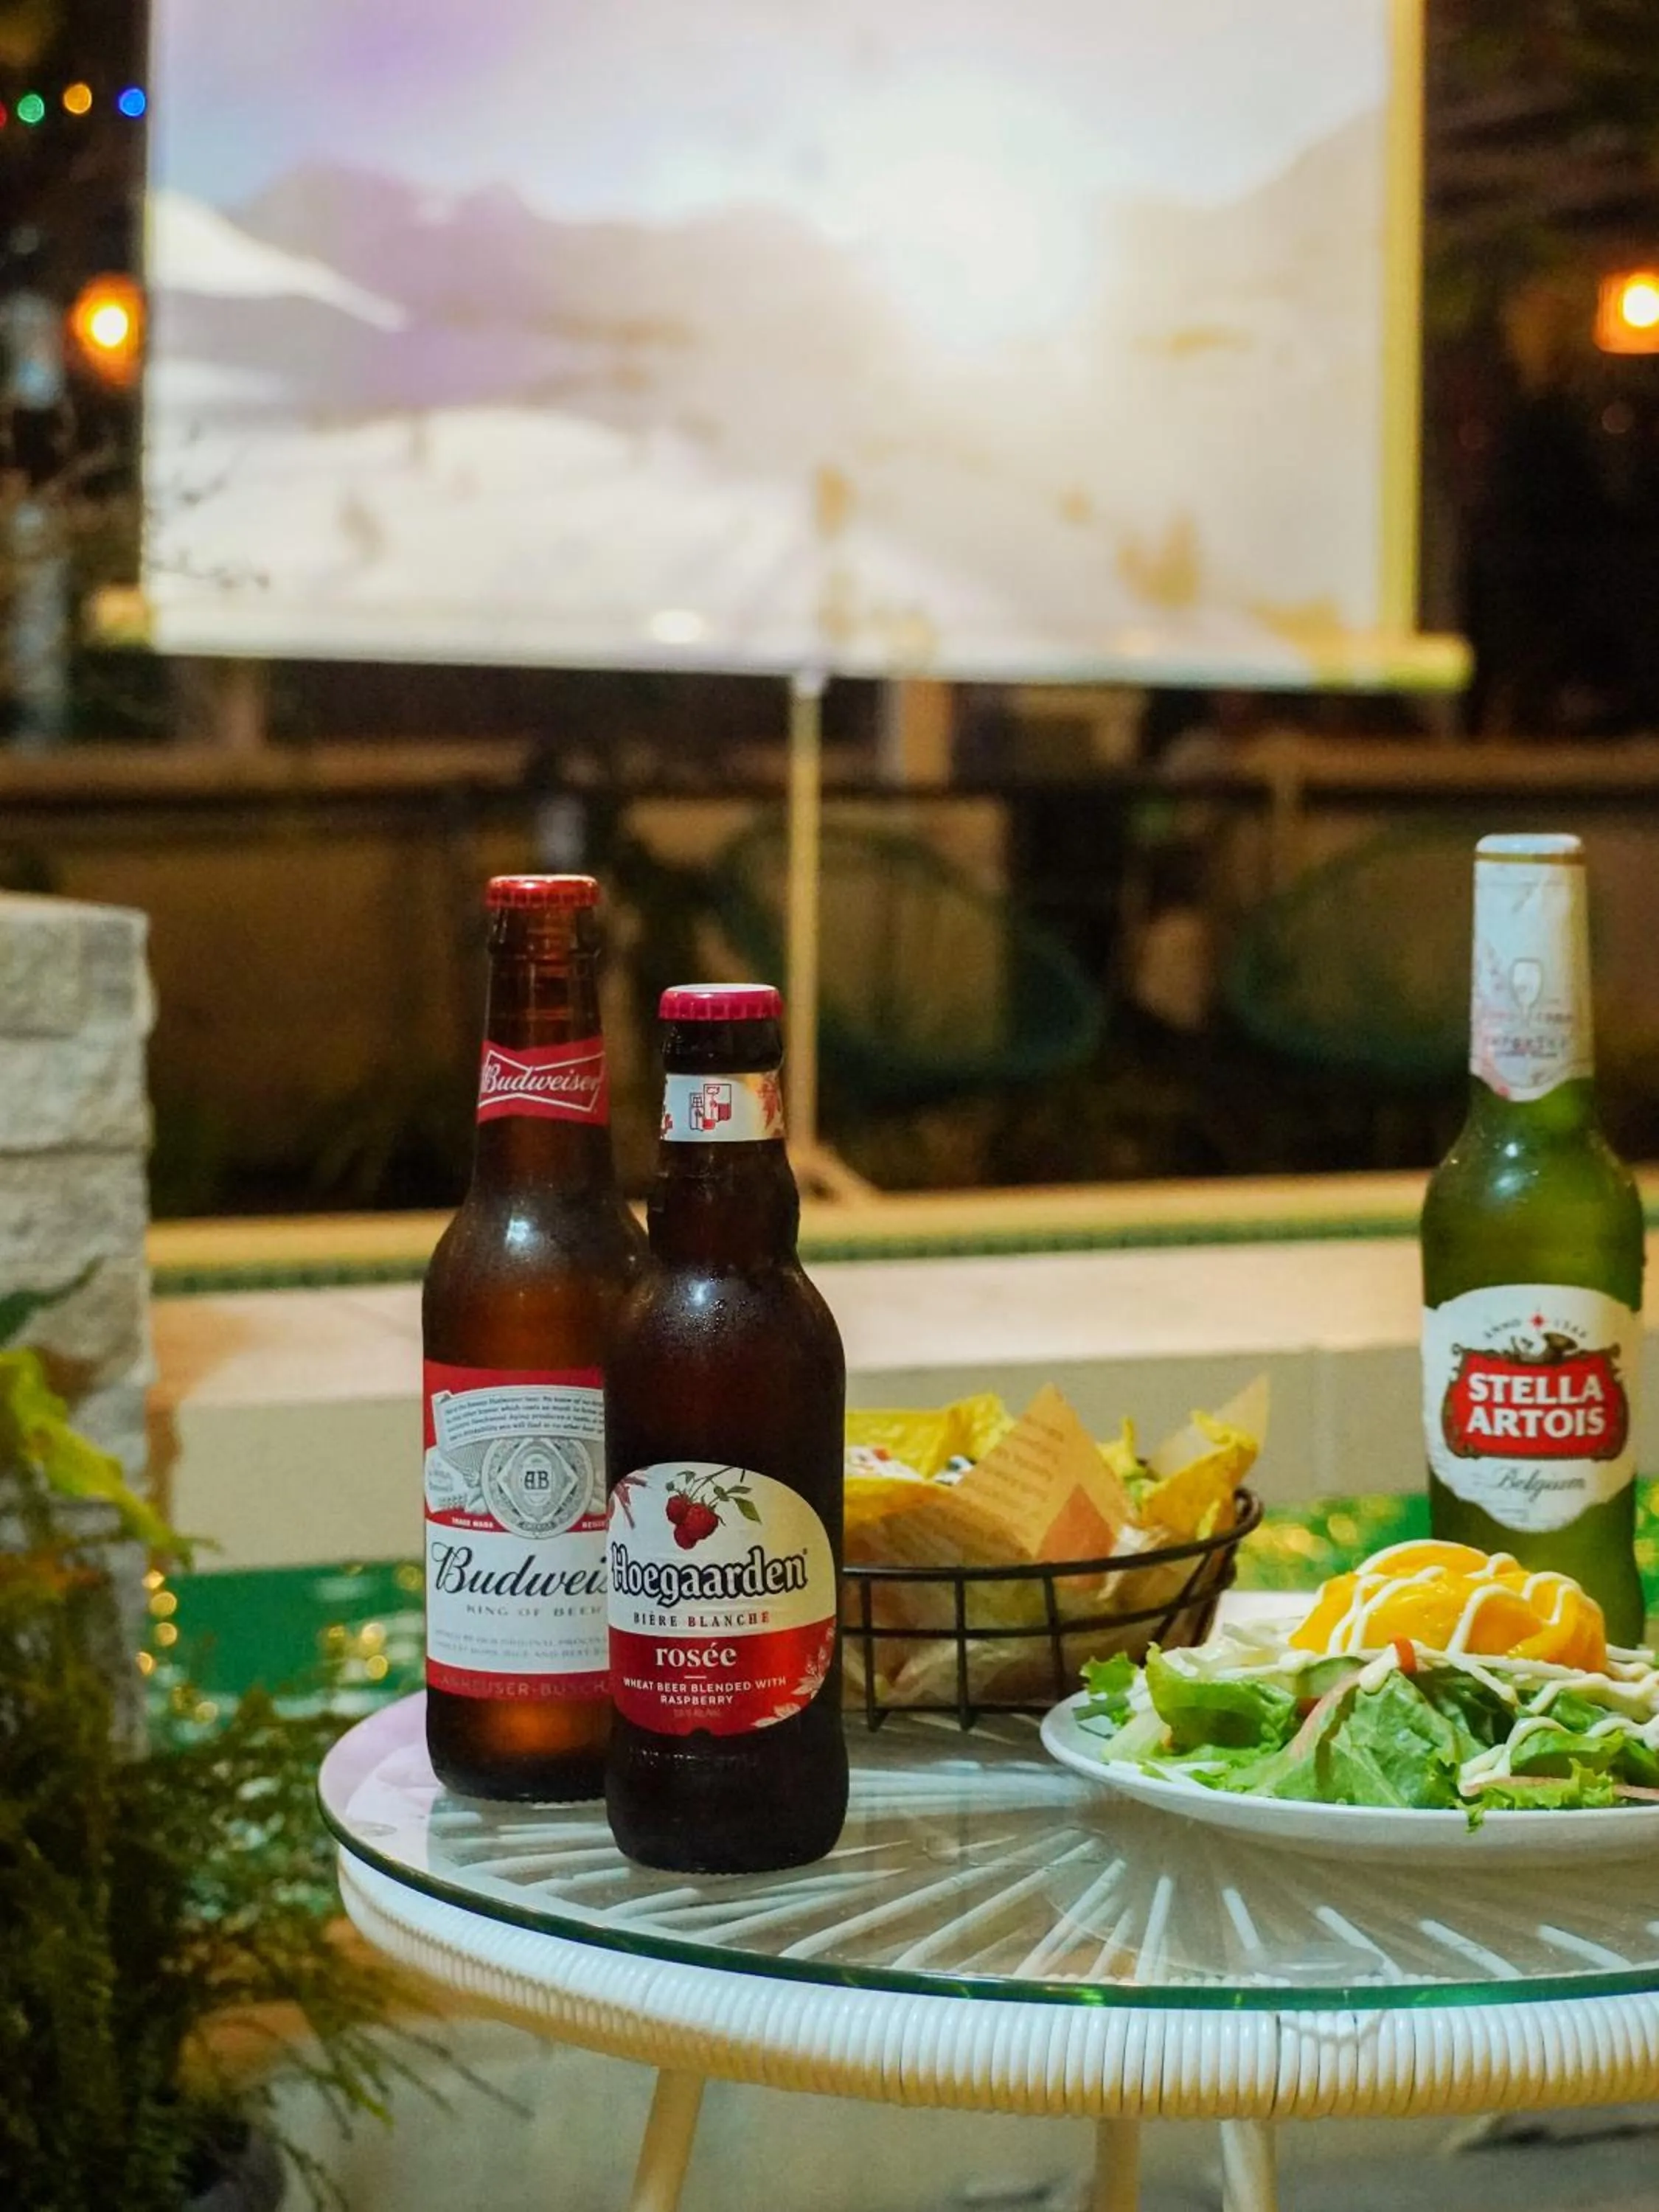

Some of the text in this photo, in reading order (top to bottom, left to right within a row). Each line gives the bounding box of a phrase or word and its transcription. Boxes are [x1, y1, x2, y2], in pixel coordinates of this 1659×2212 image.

[480, 1062, 601, 1093] Budweiser
[1468, 1372, 1604, 1404] STELLA
[1466, 1405, 1606, 1439] ARTOIS
[524, 1470, 549, 1490] AB
[1492, 1466, 1586, 1503] Belgium
[431, 1541, 608, 1597] Budwei
[611, 1541, 808, 1608] Hoegaarden
[466, 1604, 509, 1616] KING
[553, 1605, 602, 1617] BEER
[633, 1610, 770, 1627] BIÈRE BLANCHE
[655, 1642, 737, 1668] rosée
[623, 1675, 787, 1693] WHEAT BEER BLENDED WITH
[660, 1695, 733, 1705] RASPBERRY
